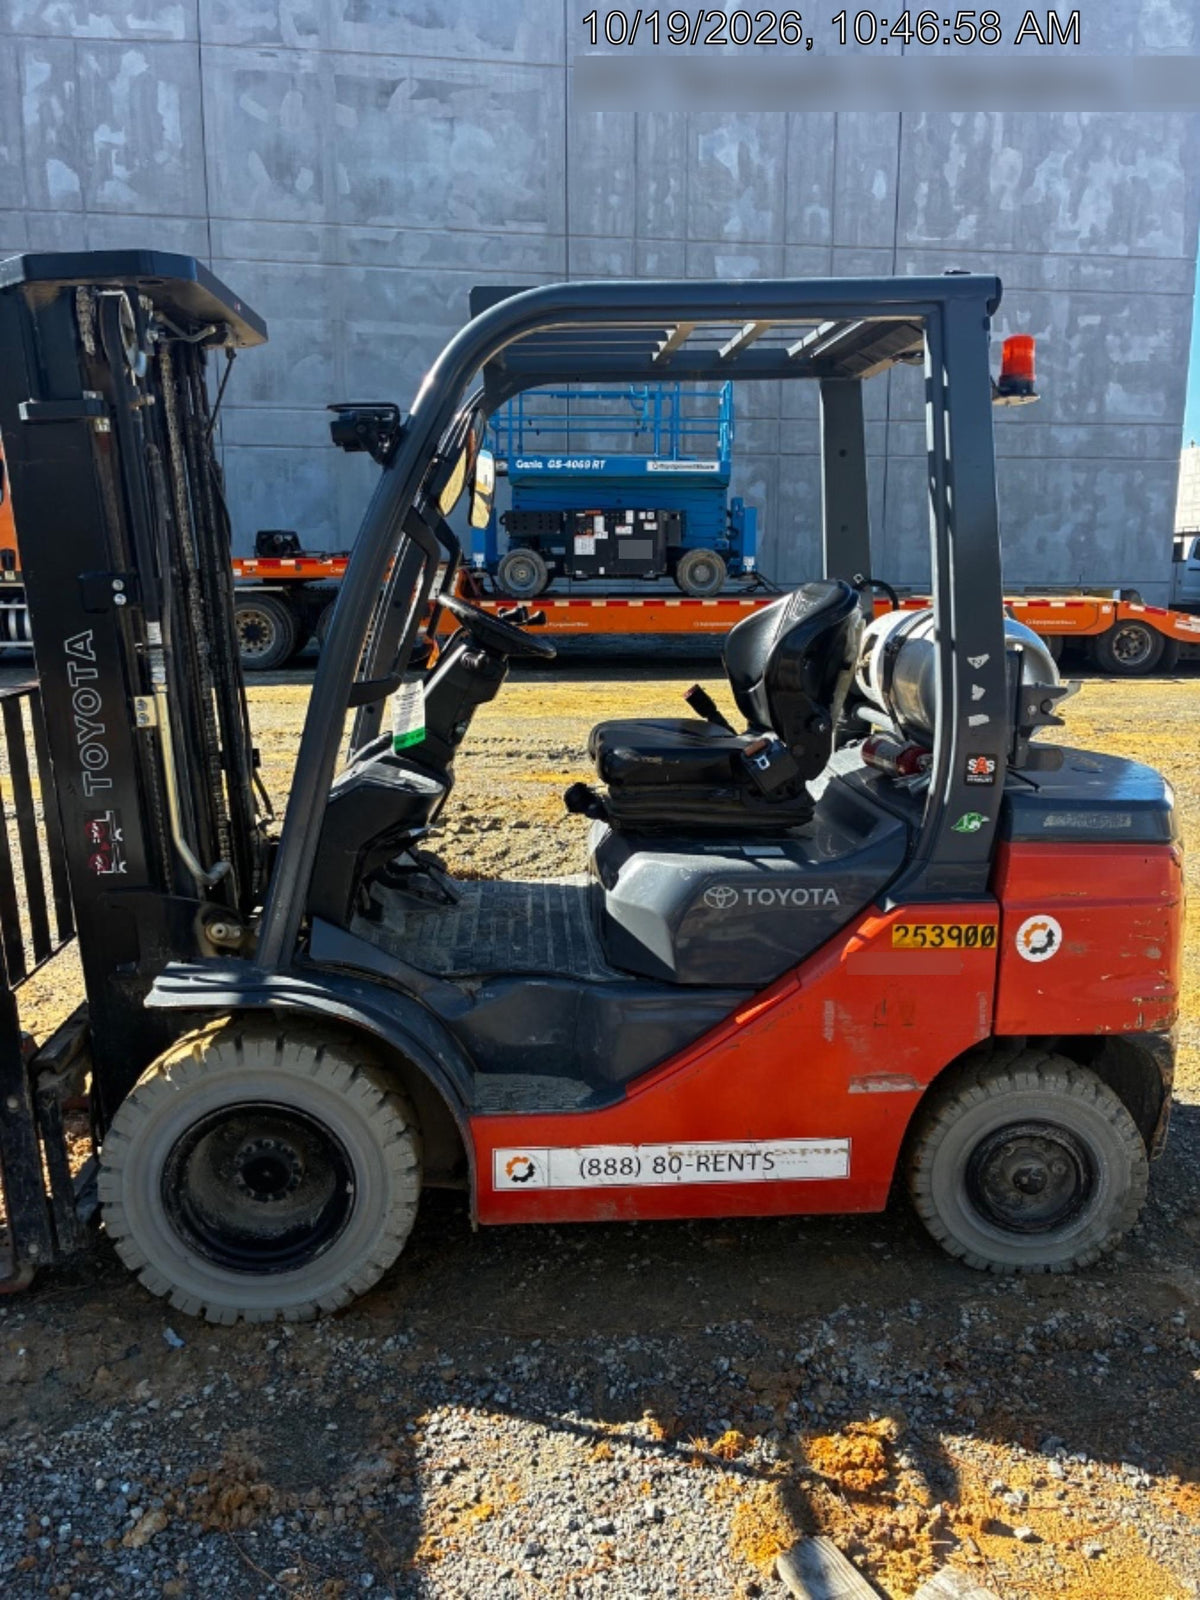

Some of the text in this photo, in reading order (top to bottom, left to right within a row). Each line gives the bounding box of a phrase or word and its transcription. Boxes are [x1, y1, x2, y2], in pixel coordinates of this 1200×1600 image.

[515, 459, 543, 469] Genie
[64, 629, 112, 797] TOYOTA
[743, 887, 840, 906] TOYOTA
[894, 924, 996, 947] 253900
[579, 1151, 775, 1178] (888) 80-RENTS
